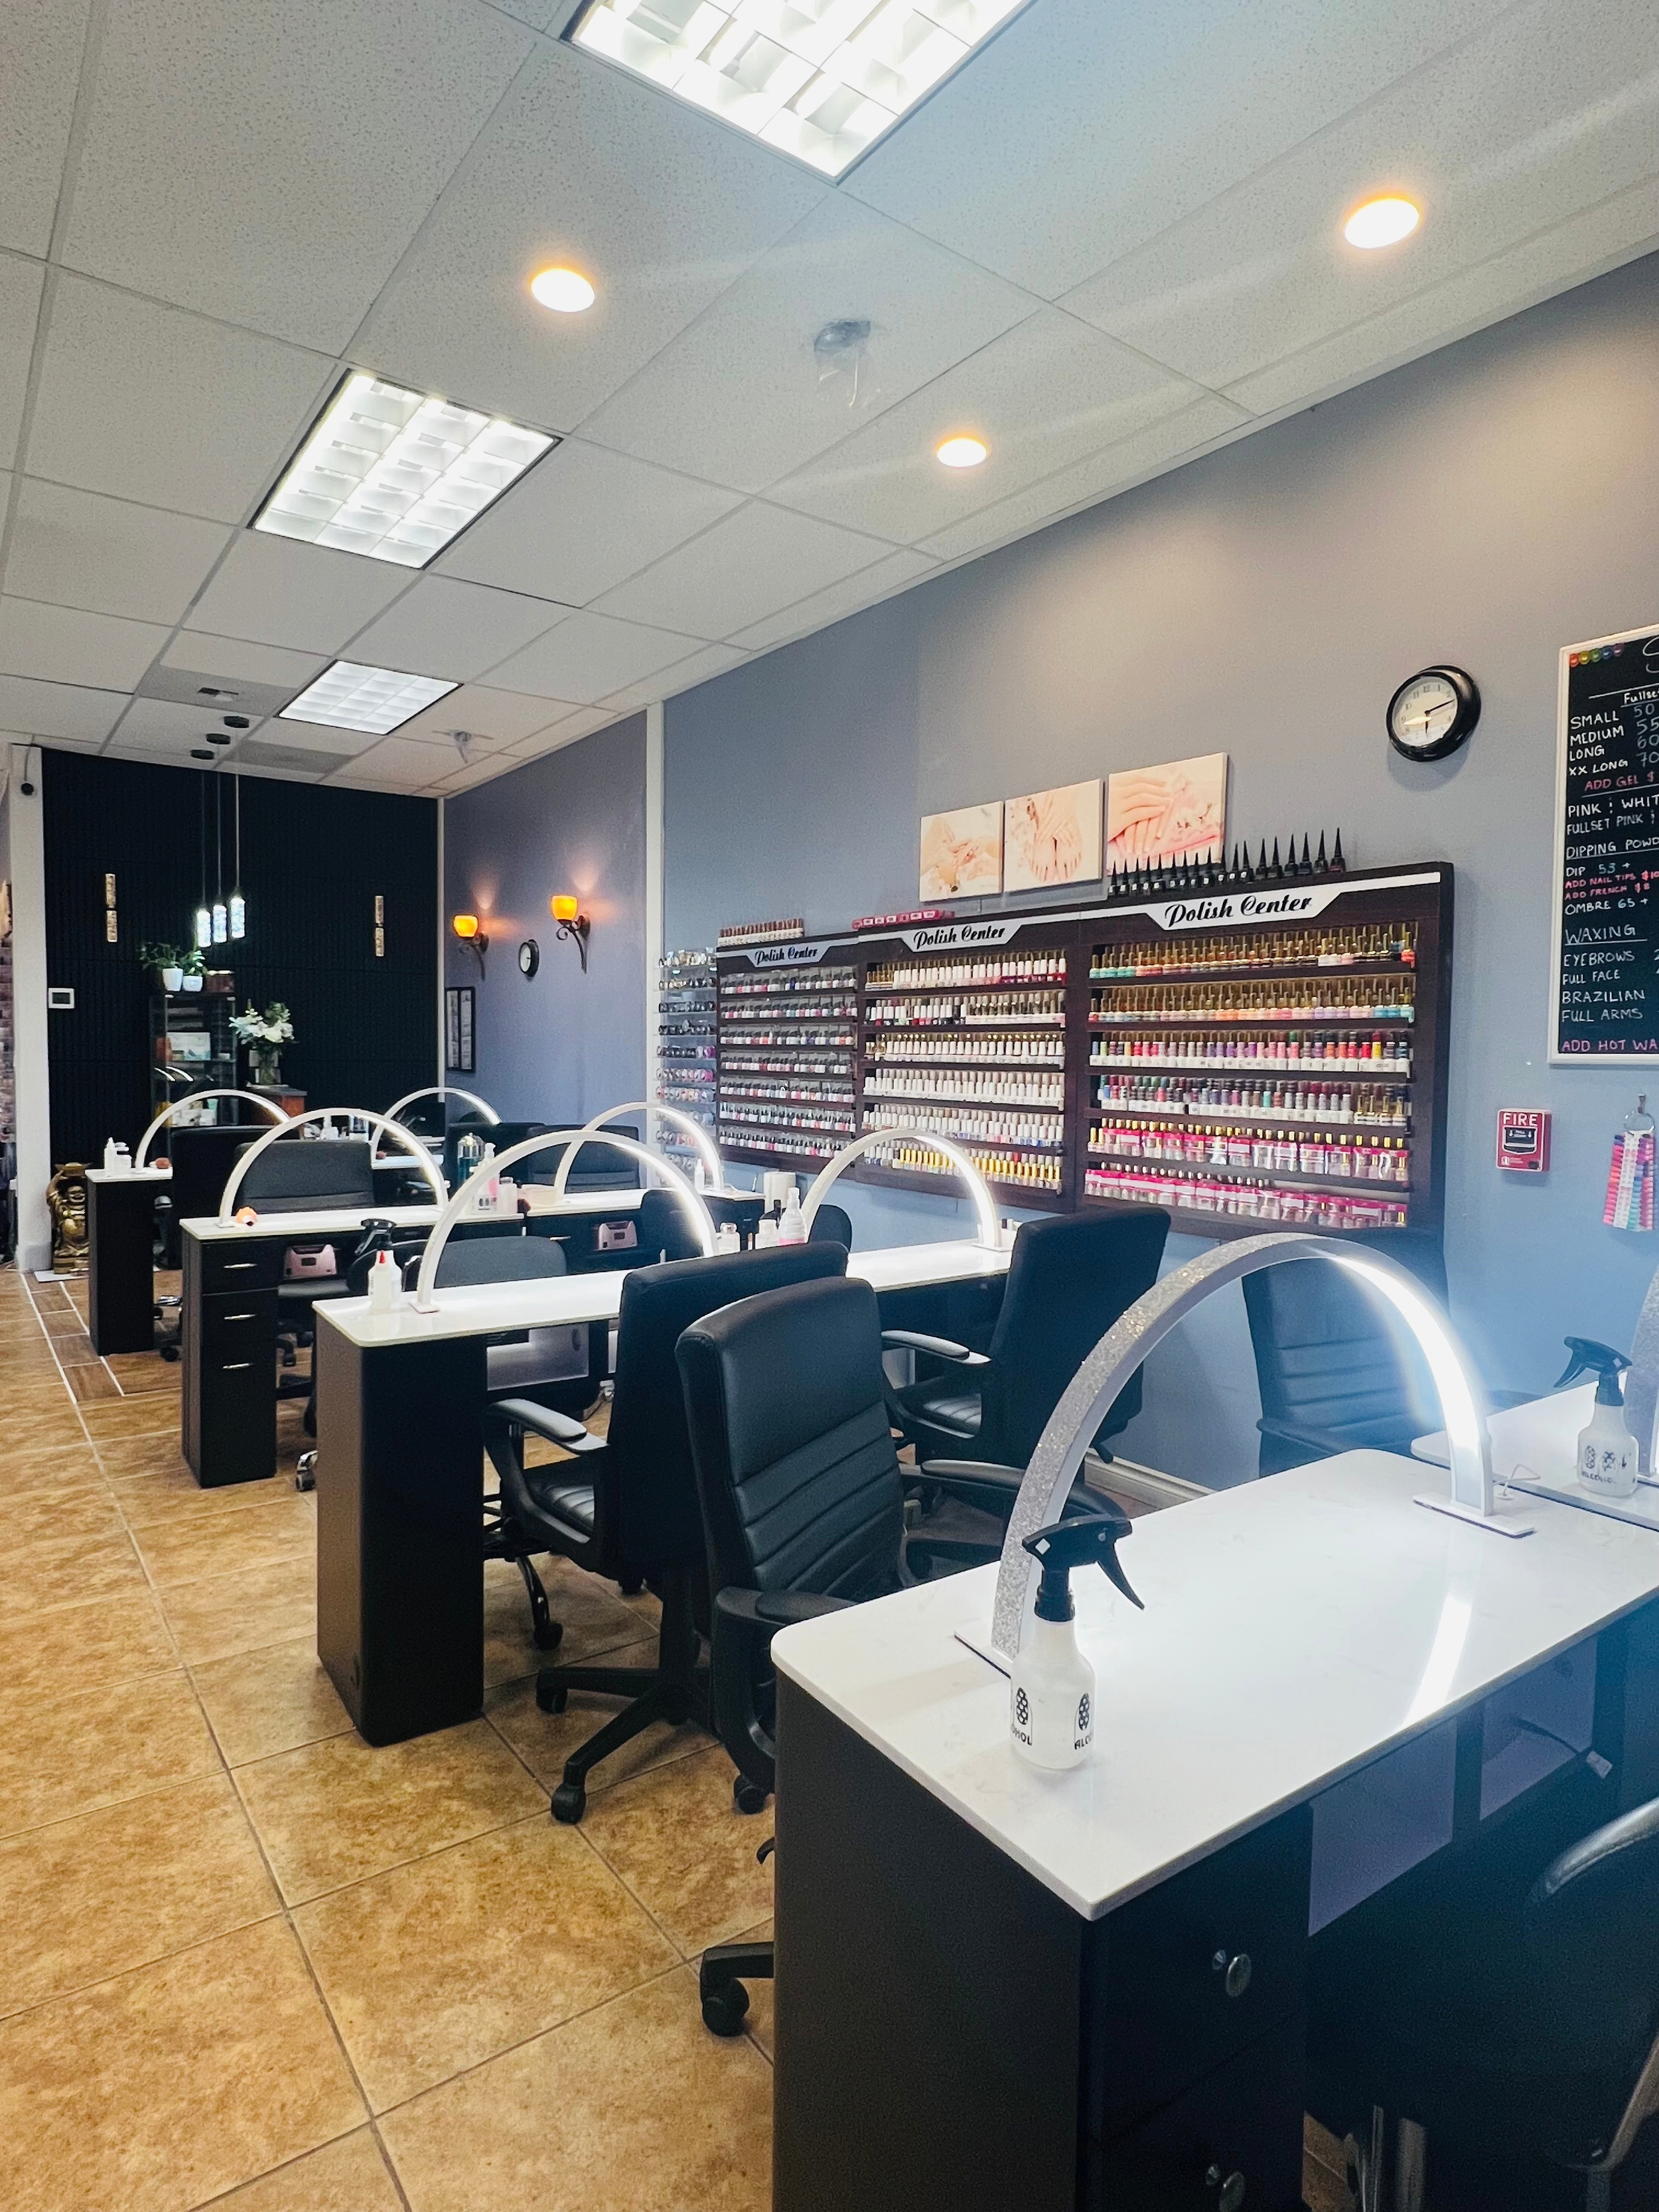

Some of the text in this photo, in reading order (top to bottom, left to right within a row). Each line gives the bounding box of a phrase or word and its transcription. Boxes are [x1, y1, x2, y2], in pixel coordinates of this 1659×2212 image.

[1570, 703, 1654, 729] SMALL 50
[1570, 717, 1659, 747] MEDIUM 55
[1569, 735, 1659, 761] LONG 60
[1593, 759, 1628, 774] LONG
[1636, 751, 1659, 768] 70
[1585, 778, 1611, 792] ADD
[1616, 775, 1638, 787] GEL
[1568, 803, 1601, 818] PINK
[1567, 818, 1610, 836] FULLSET
[1616, 814, 1643, 828] PINK
[1566, 842, 1617, 859] DIPPING
[1566, 867, 1585, 877] DIP
[1565, 880, 1586, 889] ADD
[1589, 877, 1613, 886] NAIL
[1565, 891, 1587, 900] ADD
[1590, 885, 1627, 897] FRENCH
[1165, 894, 1313, 928] Polish Center
[1565, 901, 1611, 915] OMBRE
[1618, 898, 1636, 909] 65
[913, 926, 1005, 949] Polish Center
[1565, 924, 1636, 944] WAXING
[755, 946, 818, 965] Polish Center
[1563, 950, 1635, 967] EYEBROWS
[1562, 969, 1621, 986] FULL FACE
[1561, 990, 1646, 1004] BRAZILIAN
[1561, 1007, 1643, 1022] FULL ARMS
[1561, 1039, 1591, 1052] ADD
[1598, 1039, 1626, 1051] HOT
[1503, 1112, 1538, 1127] FIRE
